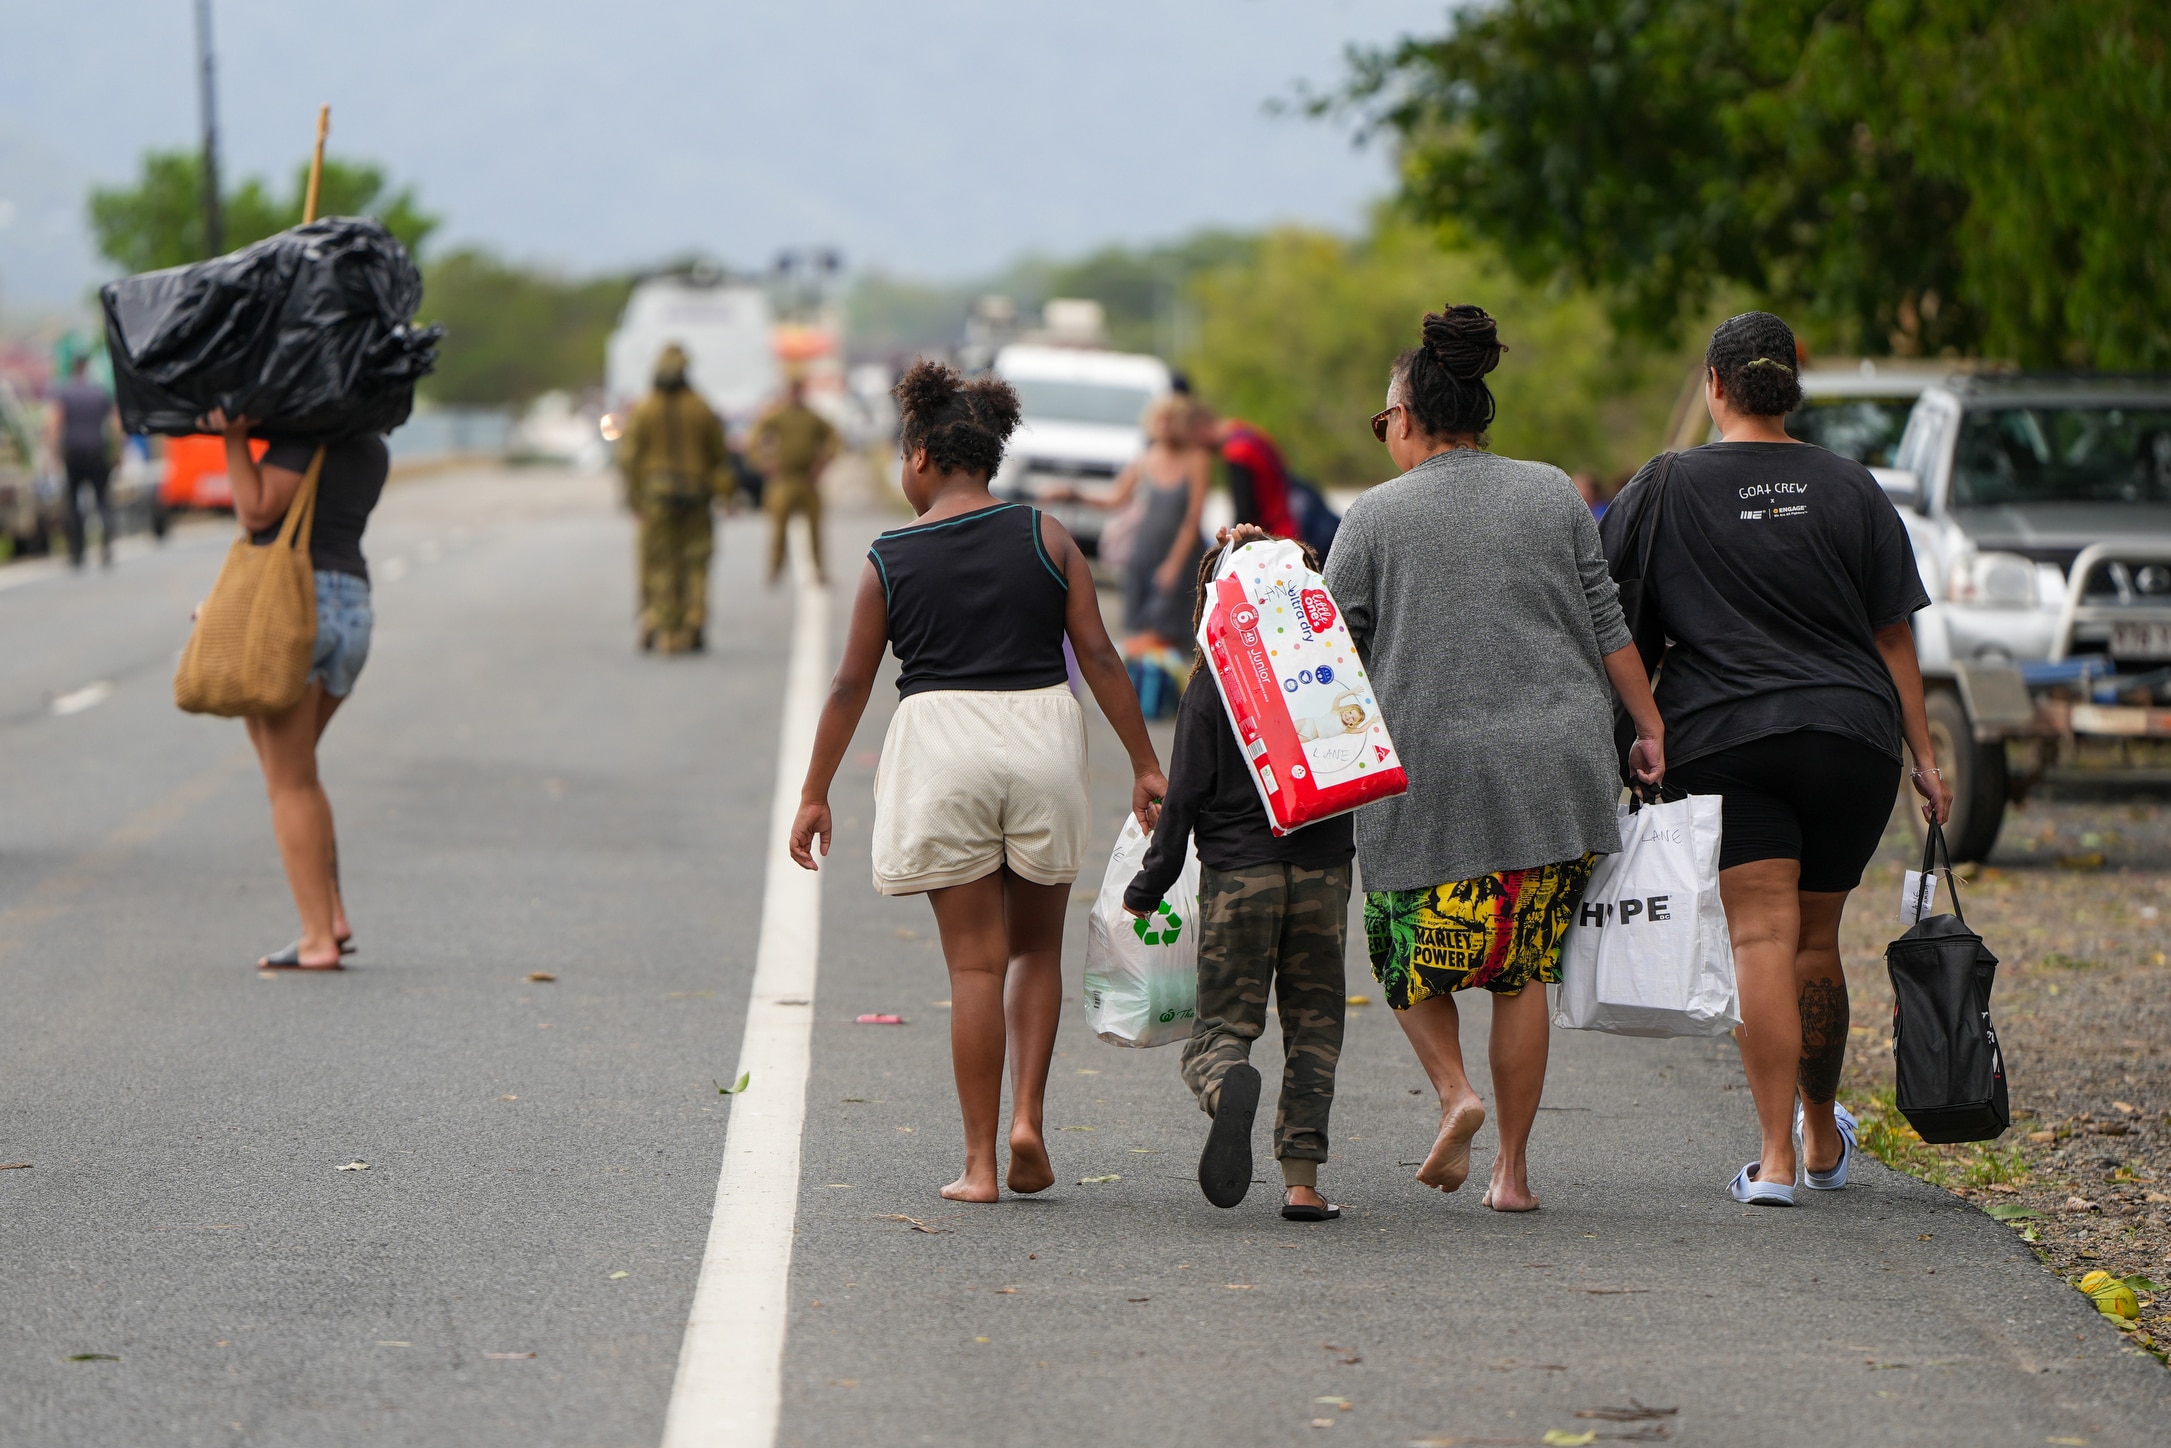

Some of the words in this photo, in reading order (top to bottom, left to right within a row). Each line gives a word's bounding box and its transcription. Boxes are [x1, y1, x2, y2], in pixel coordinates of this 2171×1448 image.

[1774, 483, 1808, 494] CREW
[1779, 505, 1804, 513] ENGAGE
[1237, 611, 1254, 624] 6
[1288, 588, 1303, 620] ultra
[1300, 621, 1314, 642] dry
[1304, 596, 1320, 627] one's
[1312, 593, 1332, 625] little
[1246, 632, 1256, 642] 40
[1250, 649, 1271, 683] Junior
[1641, 829, 1683, 844] LANE
[1414, 927, 1471, 950] MARLEY
[1414, 945, 1466, 968] POWER
